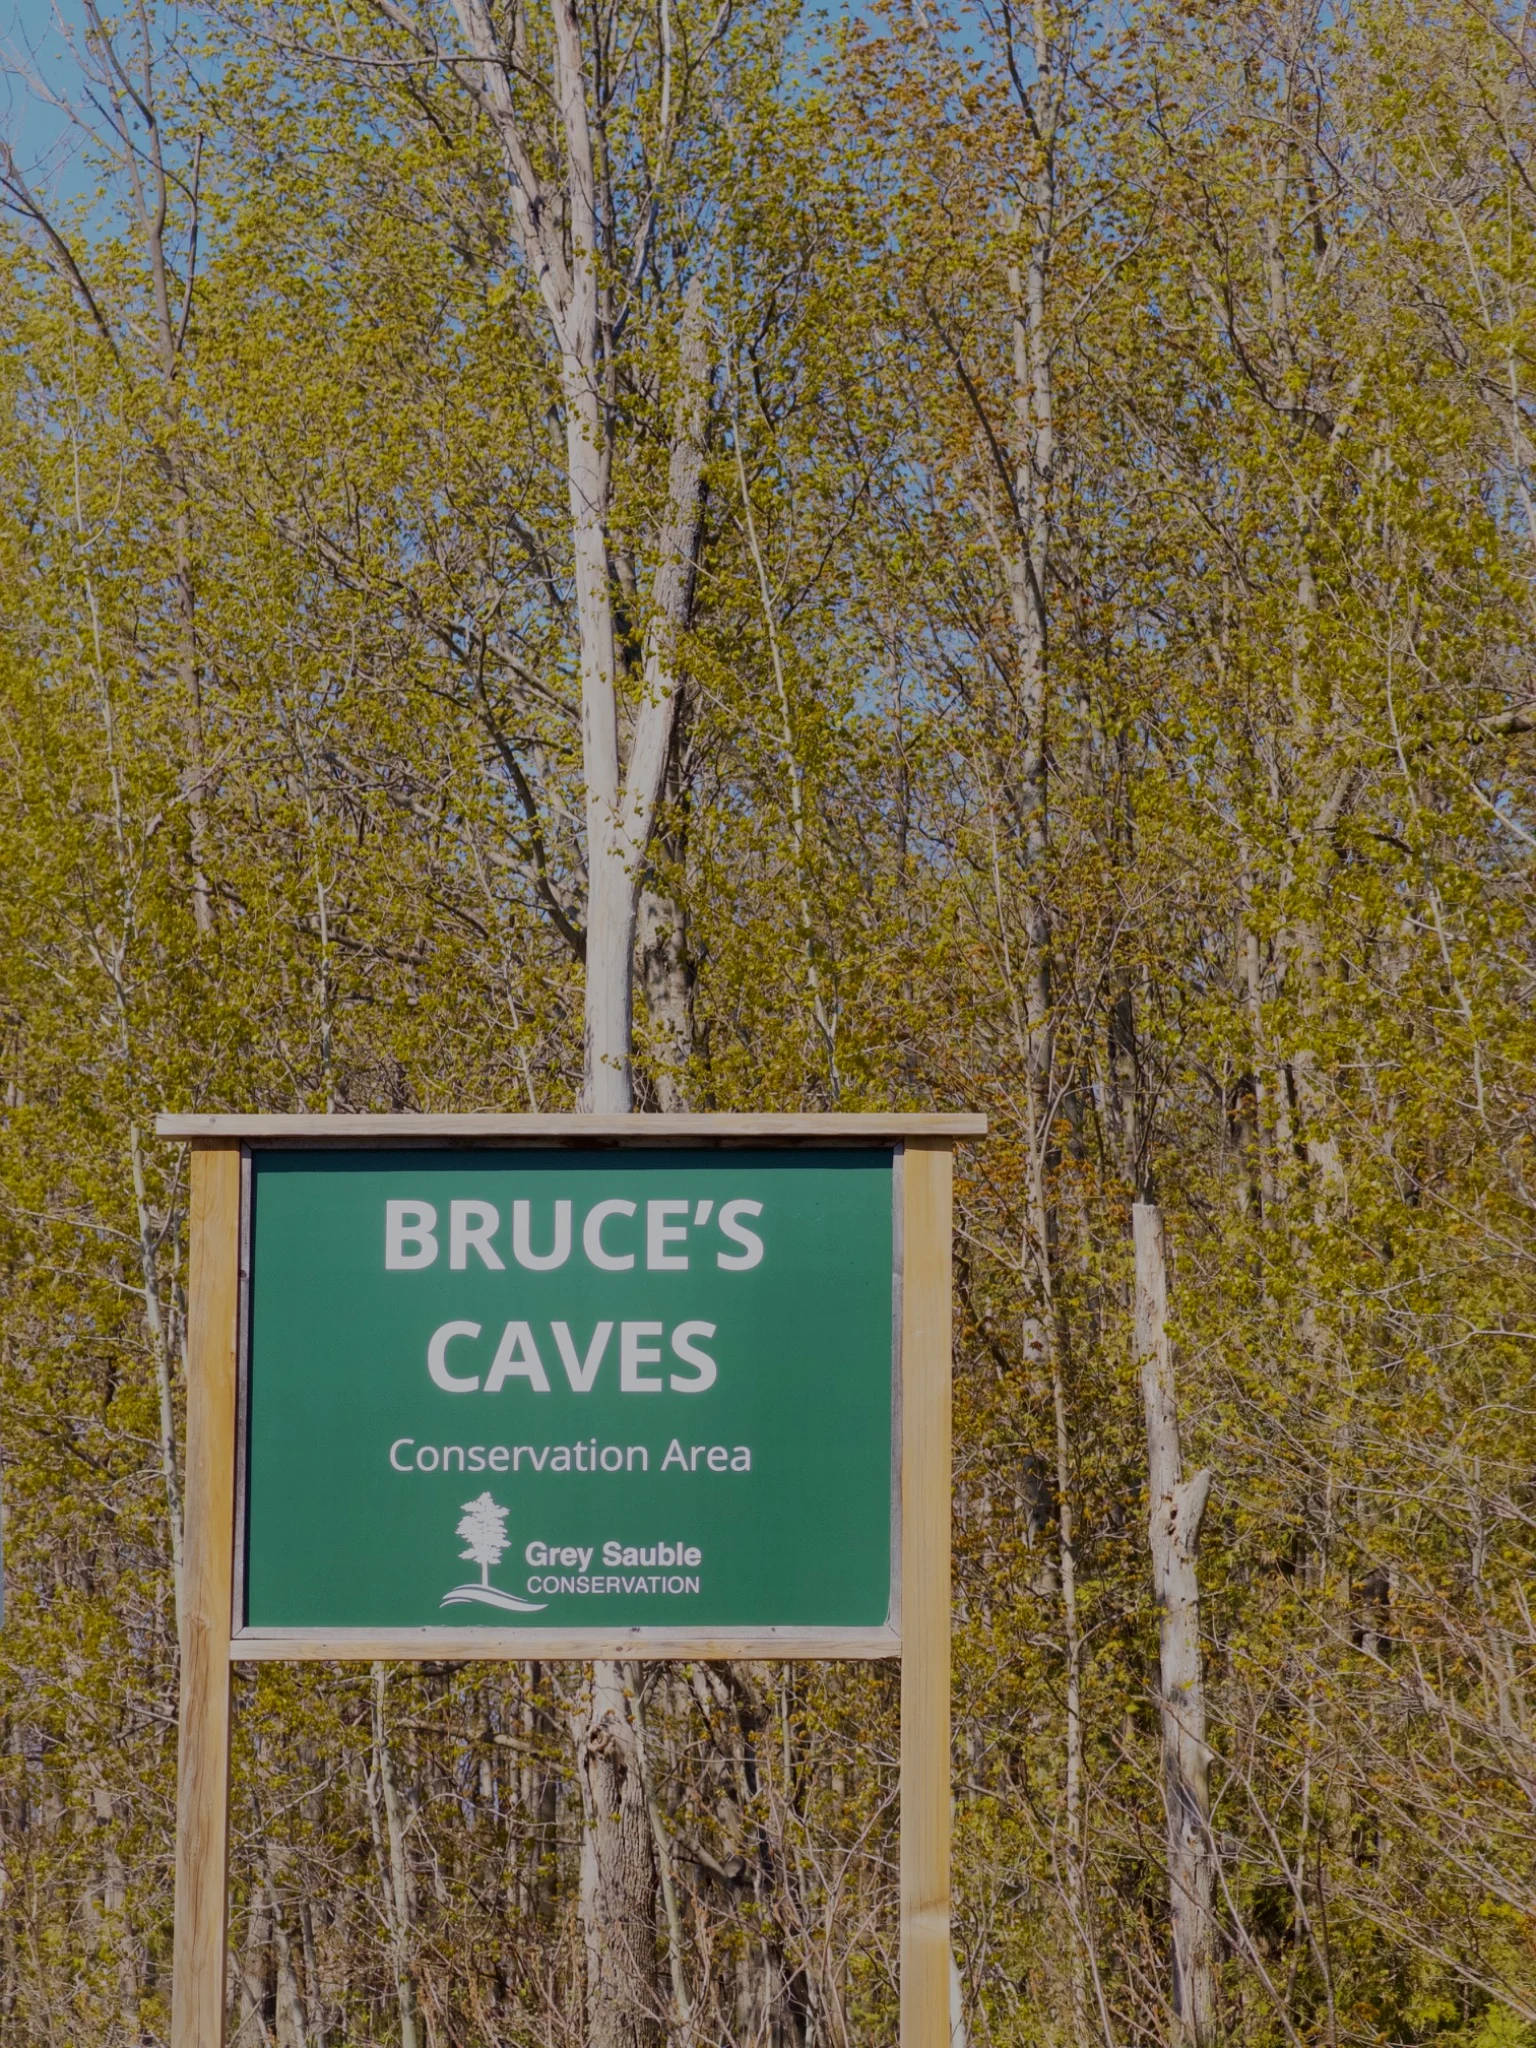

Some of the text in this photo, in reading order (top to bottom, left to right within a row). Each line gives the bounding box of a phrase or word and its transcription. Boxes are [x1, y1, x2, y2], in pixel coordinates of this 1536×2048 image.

[384, 1198, 765, 1272] BRUCE'S
[426, 1319, 718, 1393] CAVES
[389, 1438, 752, 1472] Conservation Area
[524, 1541, 702, 1573] Grey Sauble
[526, 1575, 700, 1595] CONSERVATION
